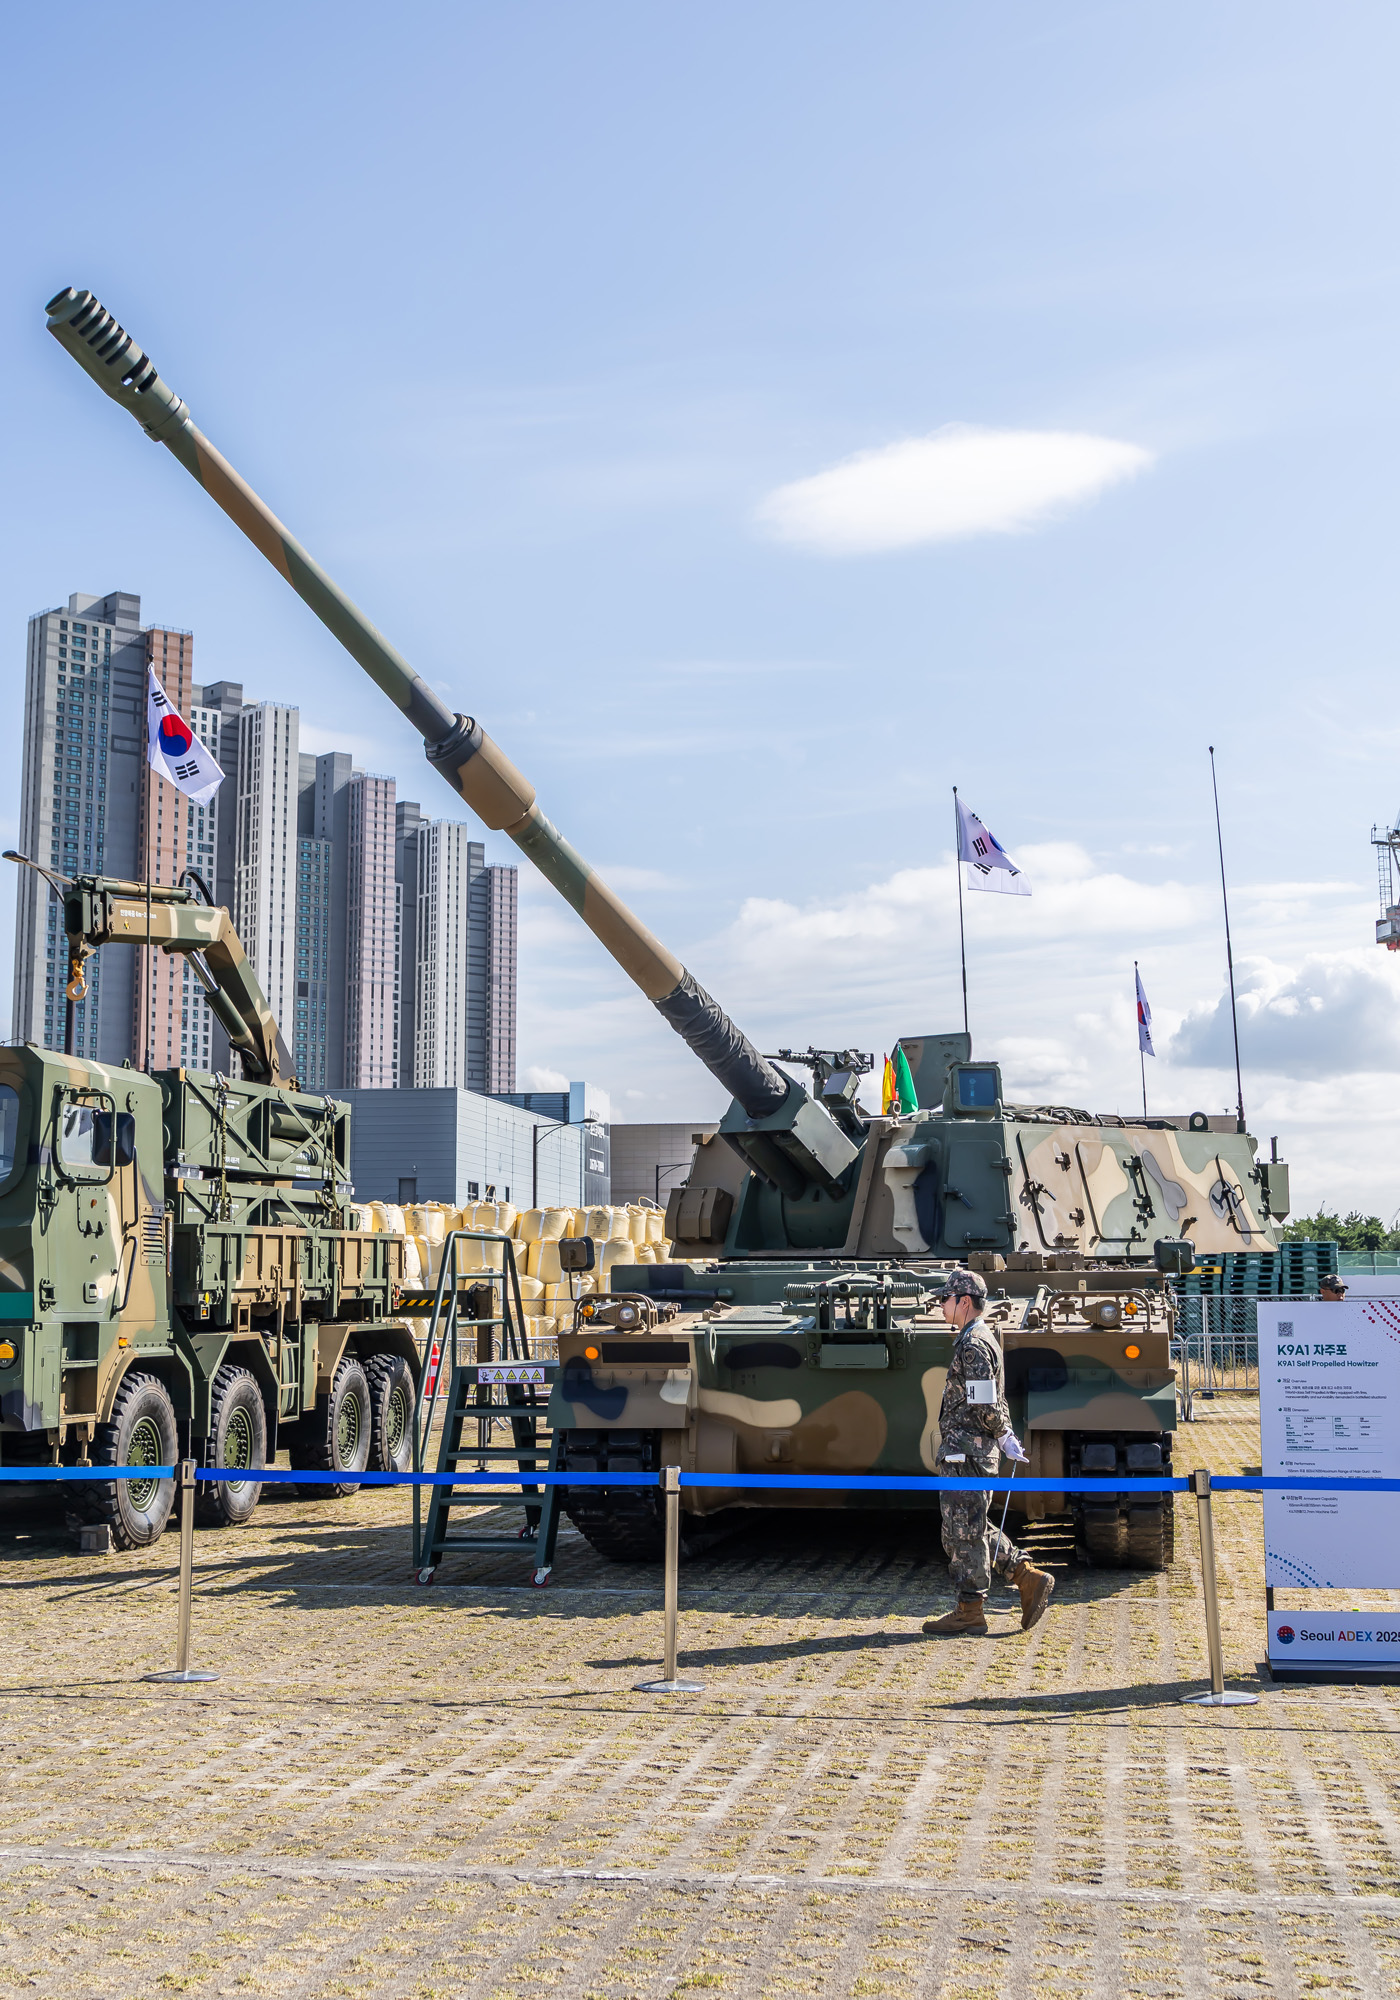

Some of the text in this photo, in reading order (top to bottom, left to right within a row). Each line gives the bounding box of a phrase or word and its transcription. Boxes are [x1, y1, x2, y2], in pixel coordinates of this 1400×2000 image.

[1277, 1344, 1347, 1356] K9A1 자주포
[1311, 1360, 1346, 1368] Propelled
[1300, 1629, 1335, 1642] Seoul
[1337, 1630, 1373, 1642] ADEX
